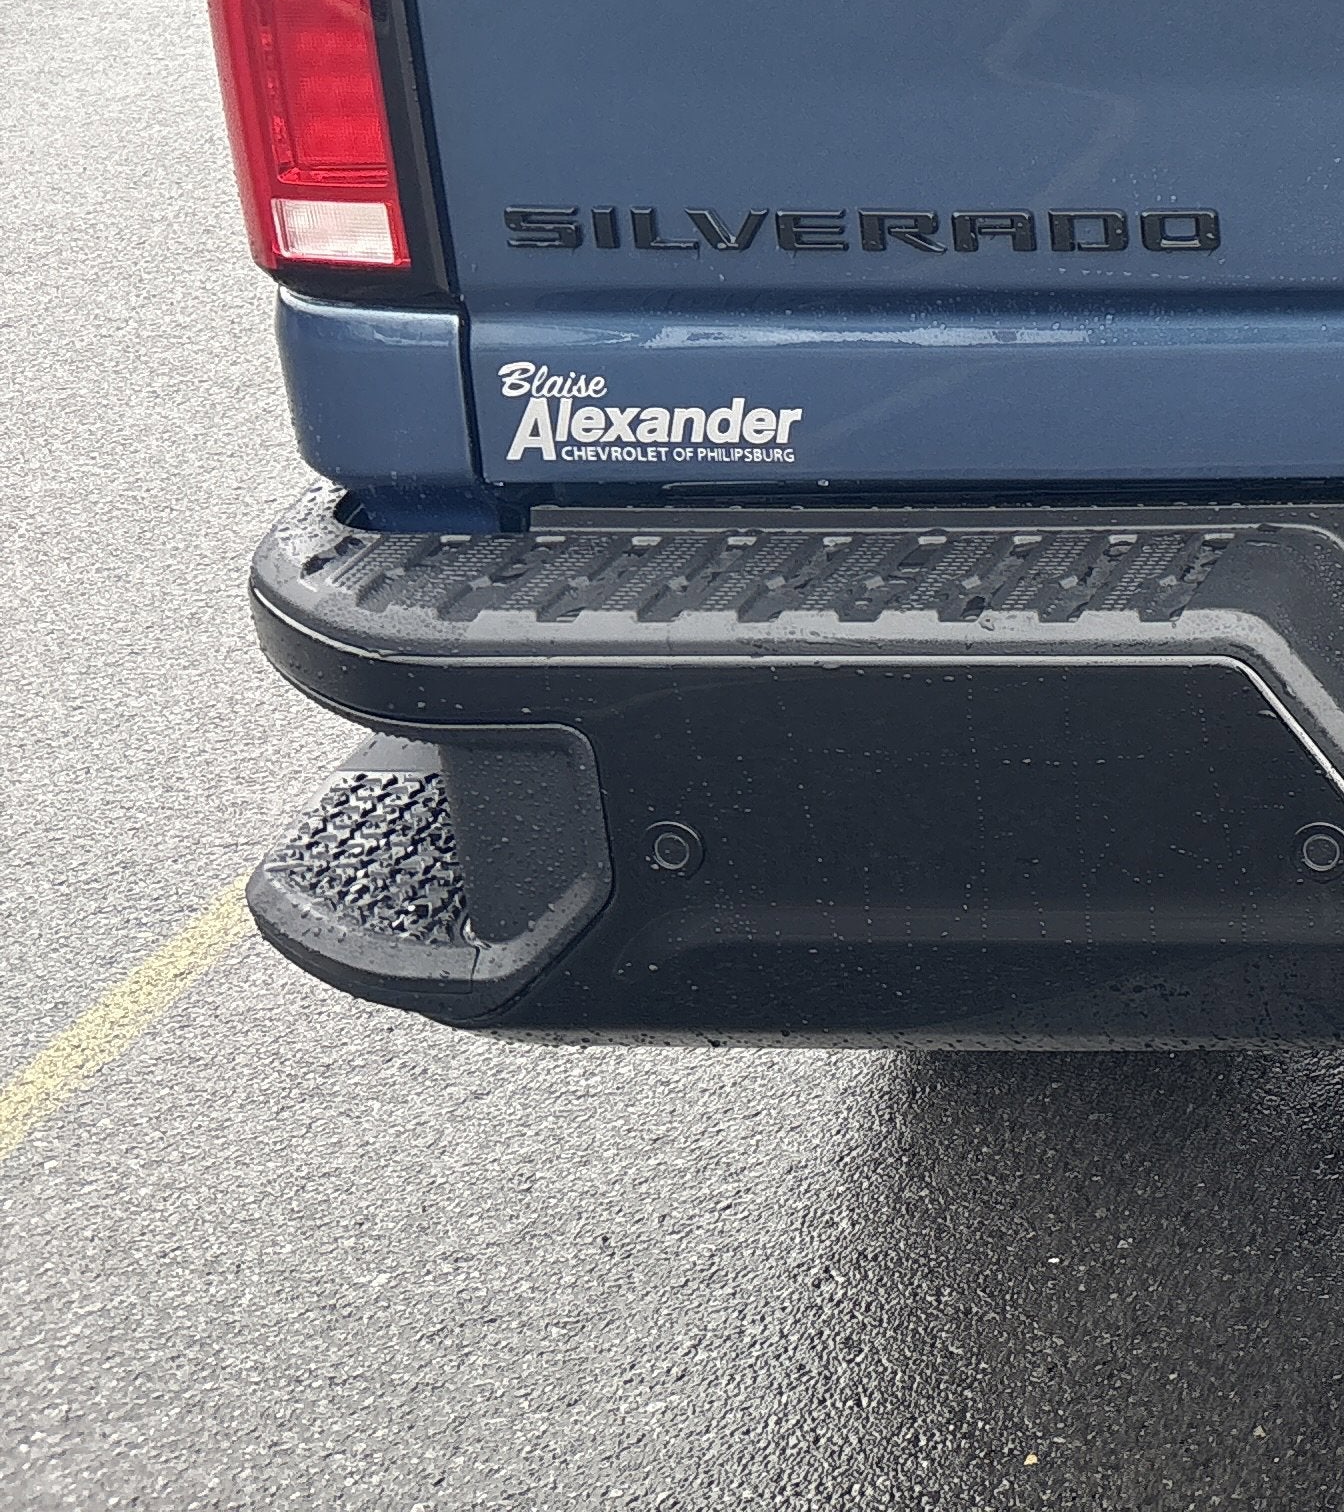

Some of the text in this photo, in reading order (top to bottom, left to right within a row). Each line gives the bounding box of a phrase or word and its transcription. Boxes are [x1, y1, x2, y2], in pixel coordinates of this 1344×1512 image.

[503, 204, 1221, 253] SILVERADO
[497, 361, 608, 398] Blaise
[506, 397, 803, 461] Alexander
[560, 446, 795, 463] CHEVROLET OF PHILIPSBURG
